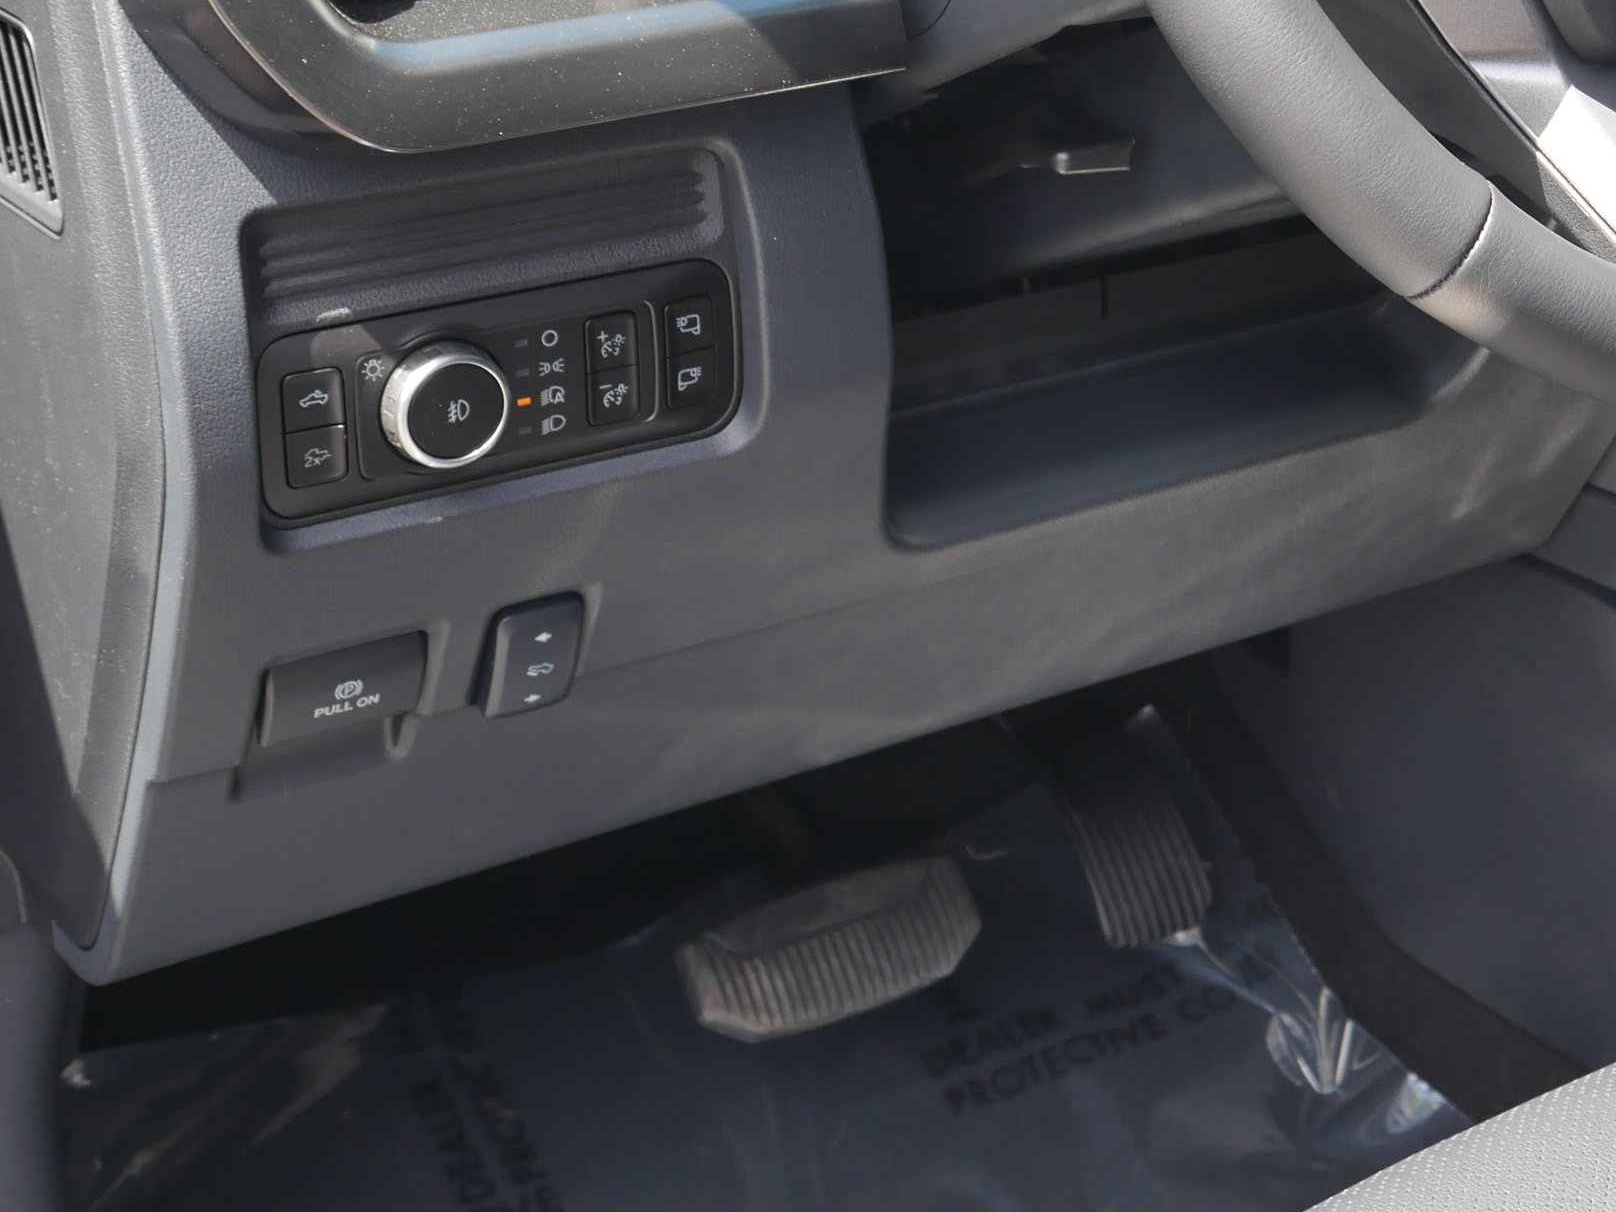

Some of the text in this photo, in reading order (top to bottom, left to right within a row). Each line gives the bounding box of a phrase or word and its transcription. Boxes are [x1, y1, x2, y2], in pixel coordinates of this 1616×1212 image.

[314, 693, 380, 718] PULL ON
[918, 1007, 1059, 1079] DEALER
[1081, 962, 1182, 1019] MUST
[943, 1011, 1168, 1117] PROTECTIVE
